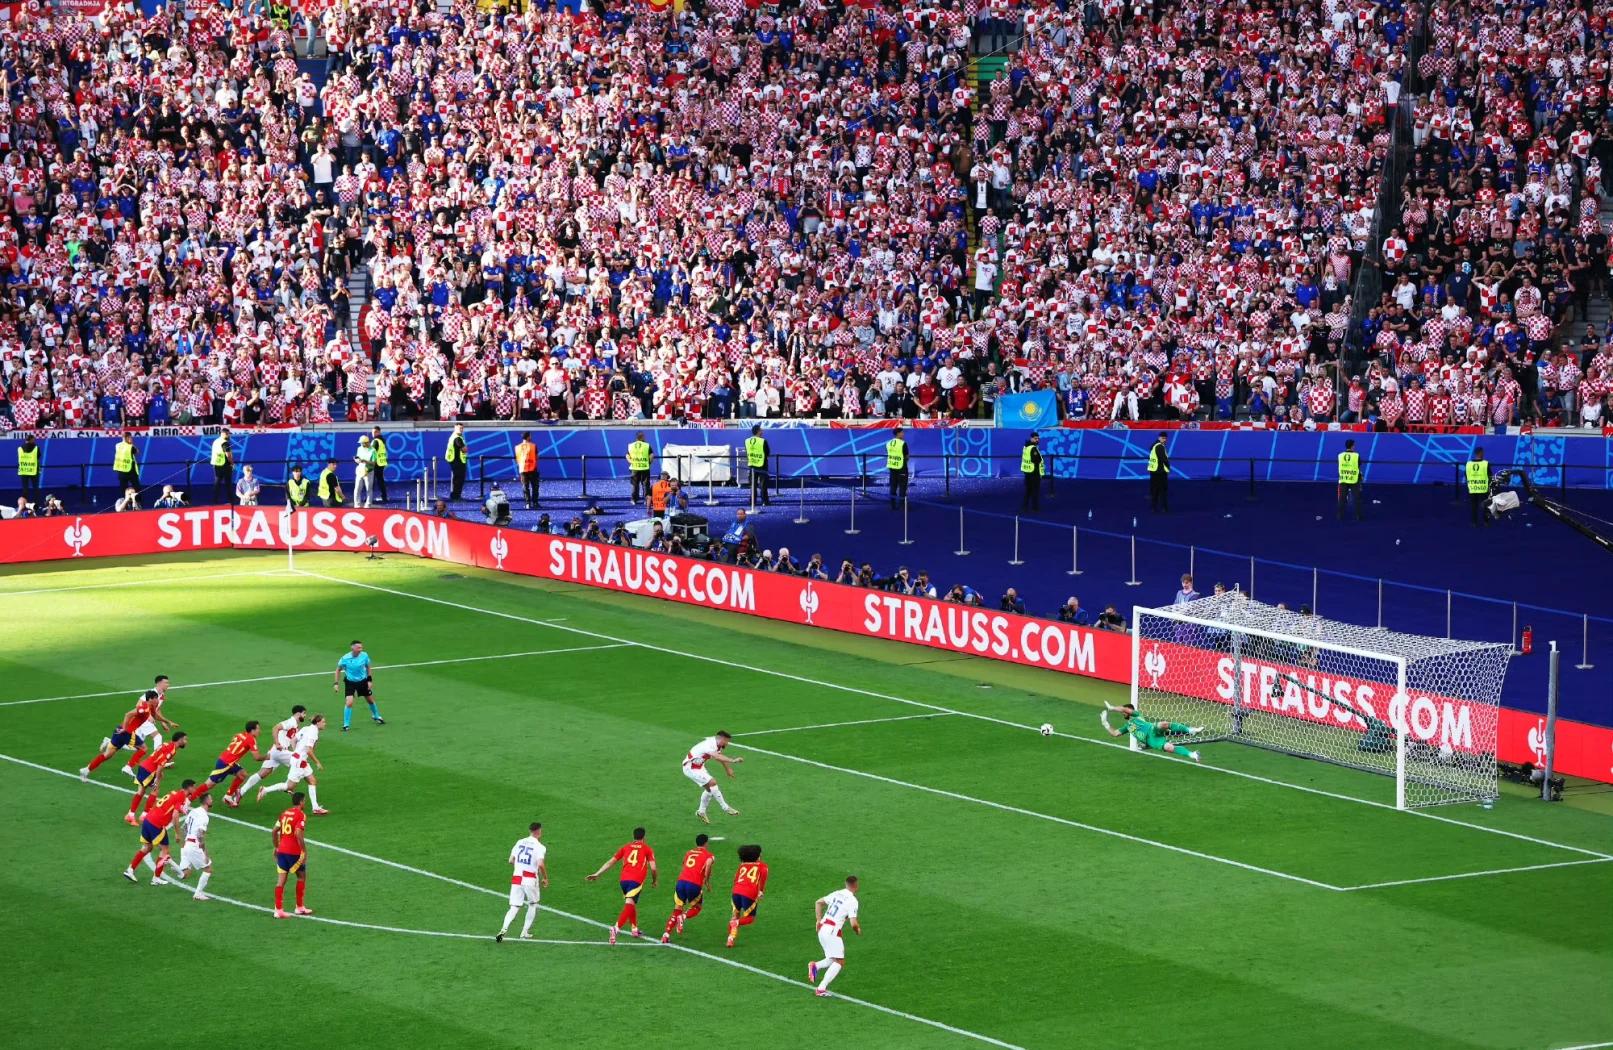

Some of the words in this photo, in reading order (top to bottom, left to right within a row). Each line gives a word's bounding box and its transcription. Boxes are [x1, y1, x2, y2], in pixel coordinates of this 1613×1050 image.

[549, 539, 756, 611] STRAUSS.COM
[864, 592, 1096, 674] STRAUSS.COM
[1216, 657, 1473, 748] STRAUSSCOM
[281, 816, 294, 835] 16
[517, 845, 534, 865] 25
[627, 849, 639, 867] 4
[686, 854, 699, 868] 6
[737, 866, 759, 883] 24
